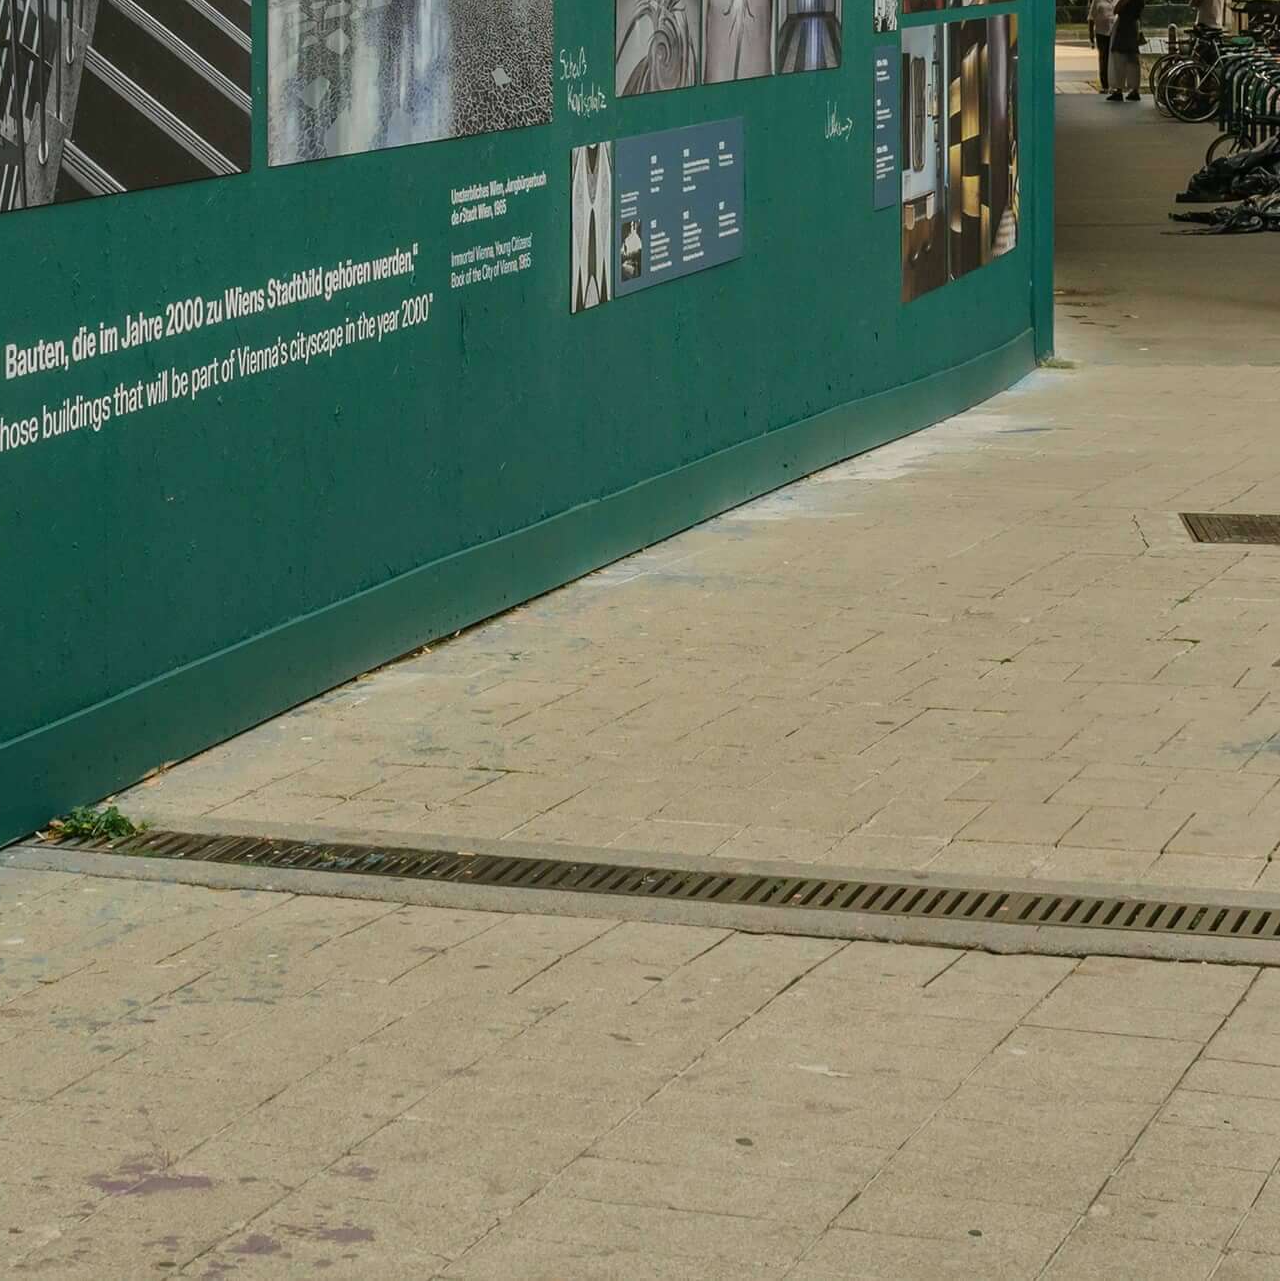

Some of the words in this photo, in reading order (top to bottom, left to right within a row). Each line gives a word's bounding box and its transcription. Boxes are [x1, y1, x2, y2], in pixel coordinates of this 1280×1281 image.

[494, 198, 507, 216] 1965
[518, 252, 531, 270] 1965
[5, 339, 69, 380] Bauten,
[72, 325, 97, 362] die
[99, 322, 118, 355] im
[121, 312, 163, 349] Jahre
[166, 296, 204, 337] 2000
[206, 299, 222, 325] zu
[225, 286, 265, 320] Wiens
[267, 266, 323, 309] Stadtbild
[324, 259, 371, 301] gehören
[42, 395, 112, 439] buildings
[113, 380, 144, 416] that
[146, 369, 169, 407] will
[171, 367, 188, 399] be
[192, 357, 219, 400] part
[221, 349, 236, 383] of
[289, 325, 343, 365] cityscape
[345, 317, 356, 344] in
[357, 311, 376, 342] the
[377, 309, 400, 343] year
